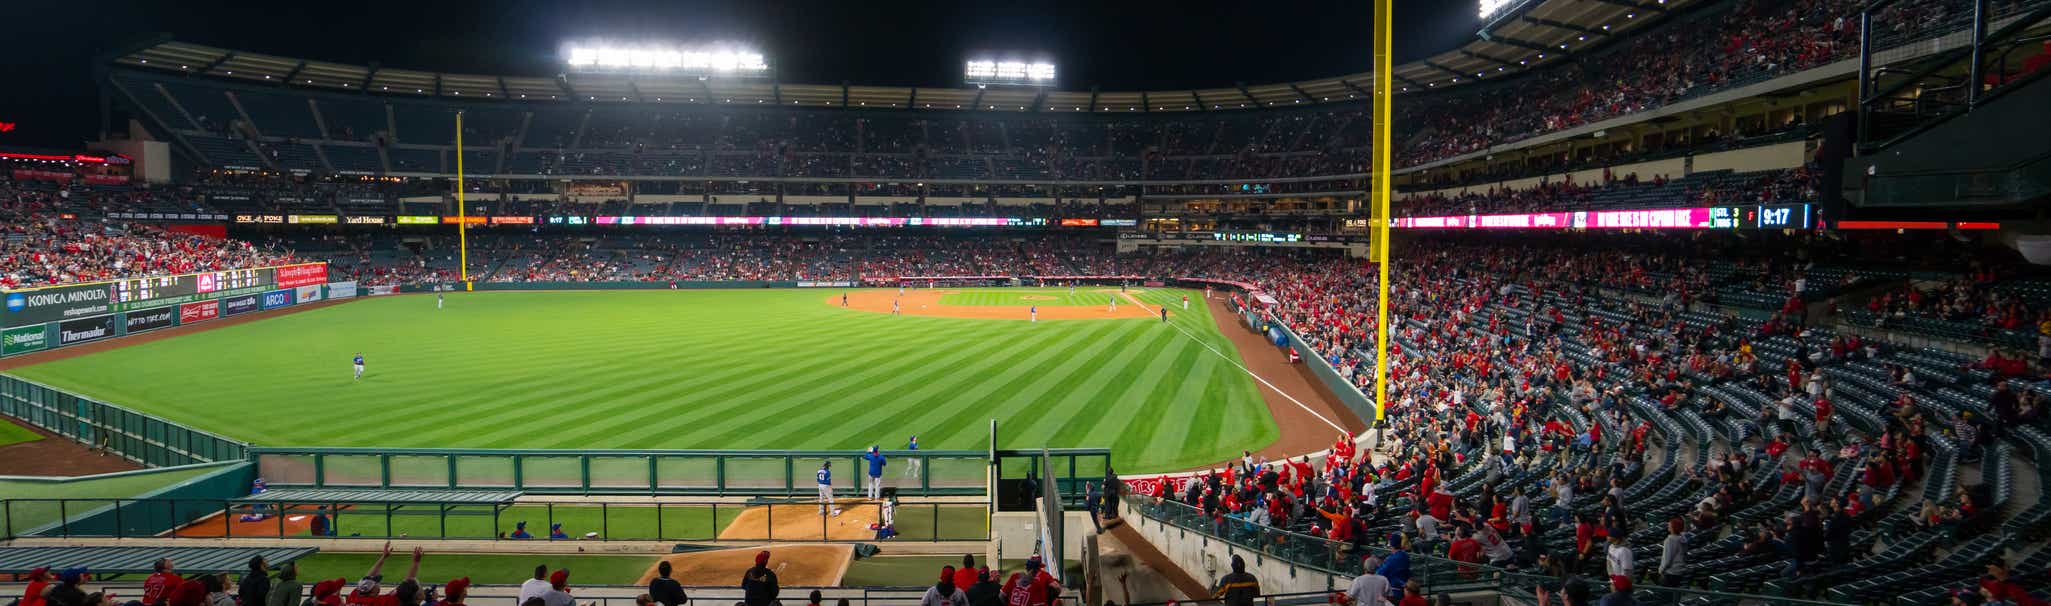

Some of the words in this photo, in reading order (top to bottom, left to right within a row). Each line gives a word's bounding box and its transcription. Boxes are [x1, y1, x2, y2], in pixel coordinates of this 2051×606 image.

[346, 216, 362, 224] Yard
[1763, 209, 1789, 224] 9:17
[28, 292, 66, 307] KONICA
[67, 288, 107, 303] MINOLTA
[266, 293, 284, 306] ARCO
[14, 331, 45, 344] National
[62, 326, 105, 342] Thermador
